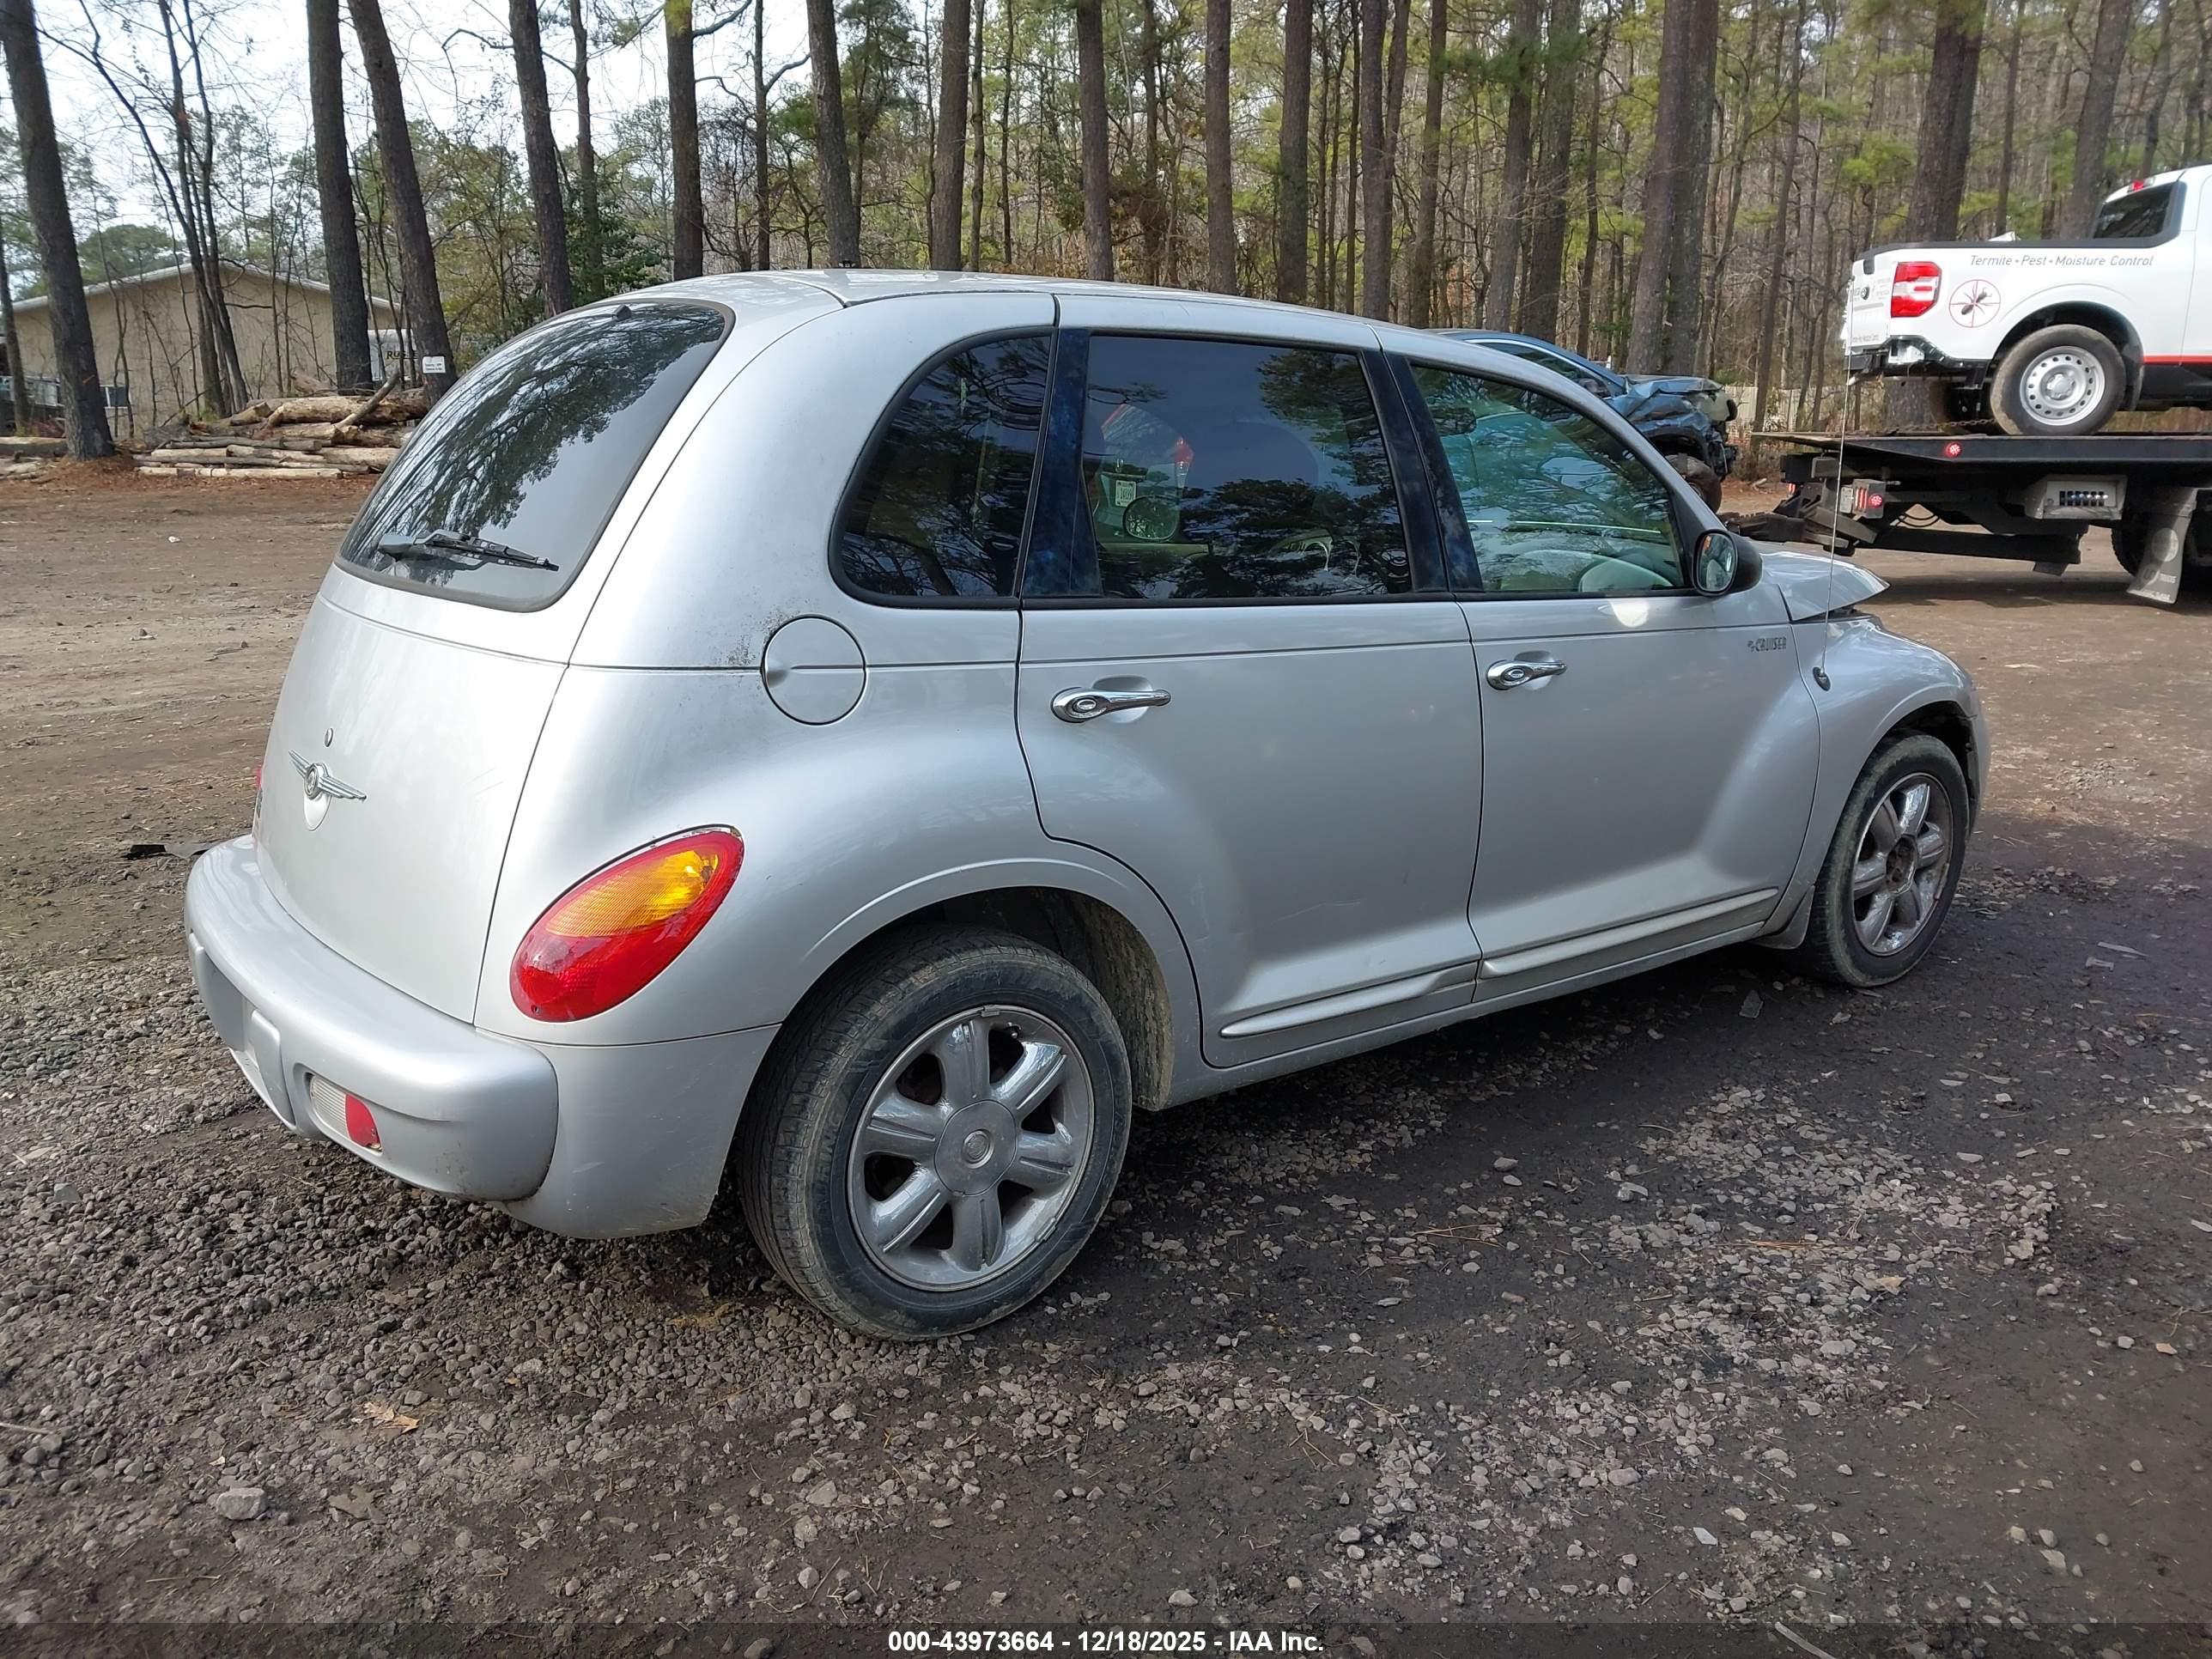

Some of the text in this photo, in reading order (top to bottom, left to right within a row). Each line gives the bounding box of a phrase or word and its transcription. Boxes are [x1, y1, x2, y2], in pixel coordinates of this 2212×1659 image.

[1971, 254, 2154, 266] Termite Pest Moisture Control
